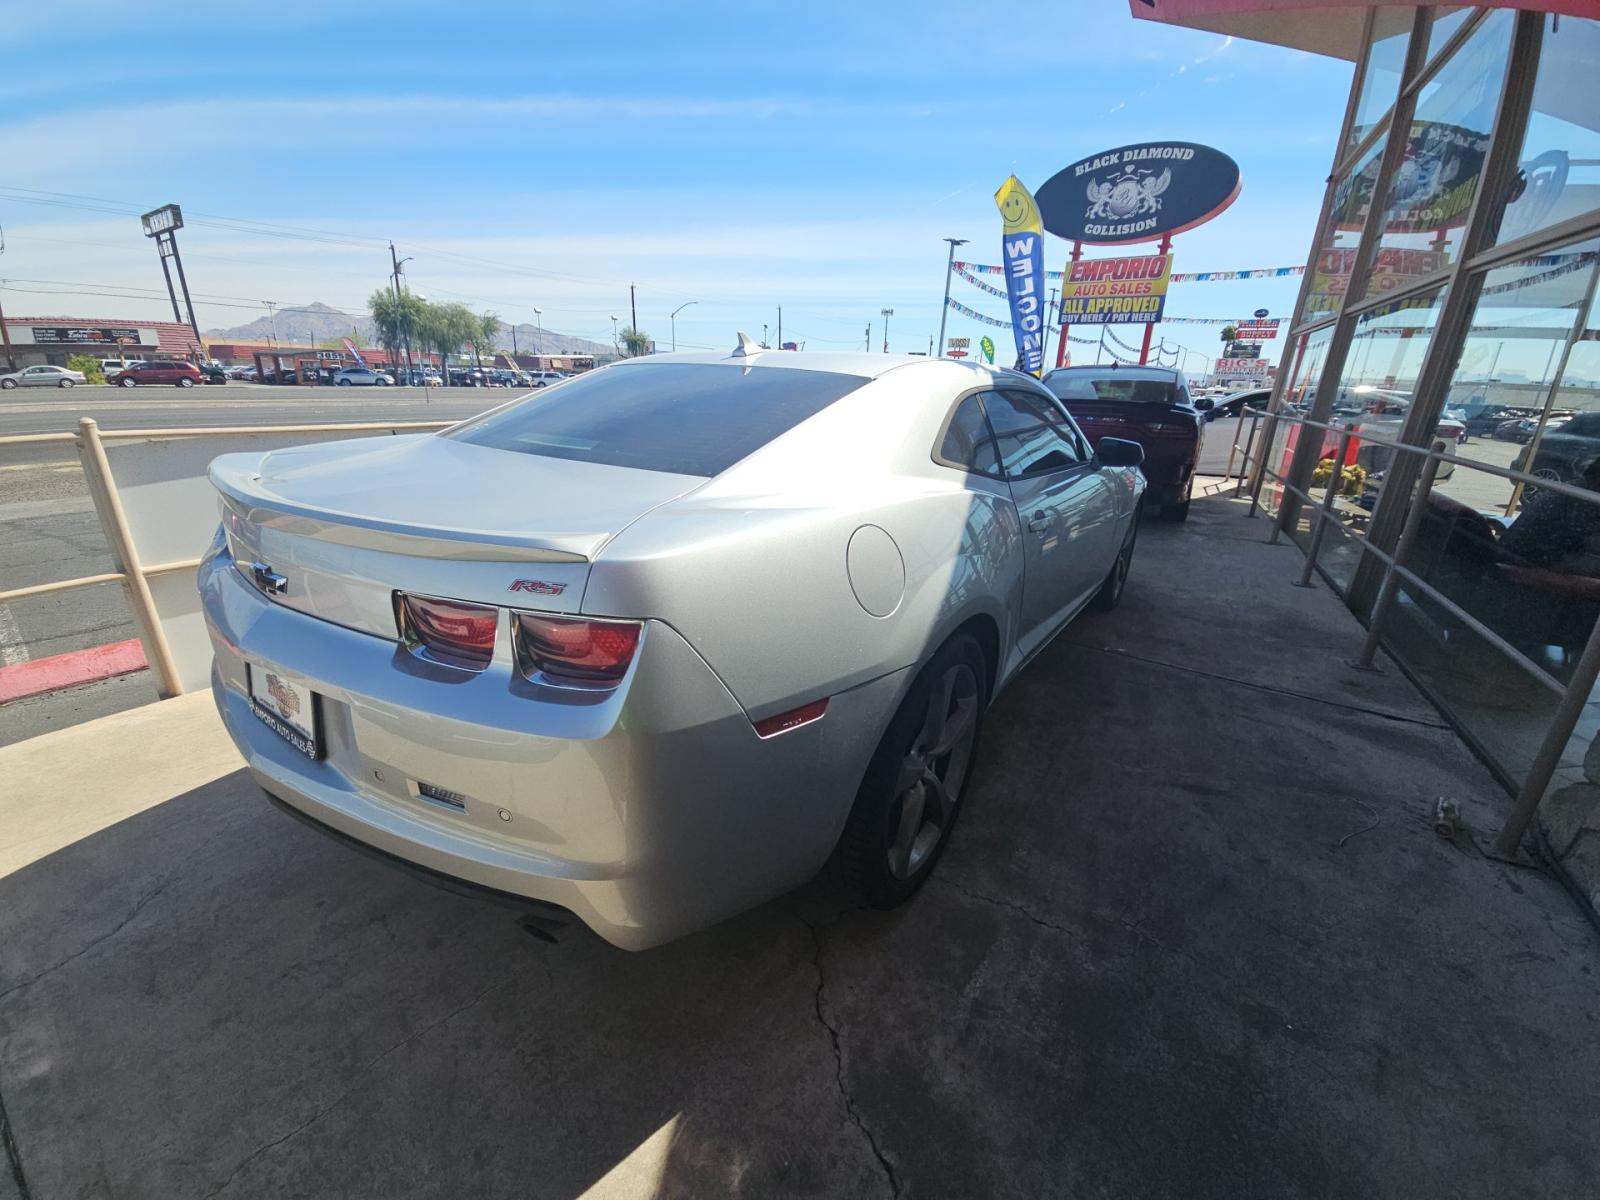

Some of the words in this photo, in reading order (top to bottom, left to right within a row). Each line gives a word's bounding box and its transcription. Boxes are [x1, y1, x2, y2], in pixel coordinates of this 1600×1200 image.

[1075, 153, 1120, 176] BLACK
[1123, 147, 1195, 162] DIAMOND
[1084, 217, 1157, 235] COLLISION
[1069, 256, 1168, 283] EMPORIO
[1073, 284, 1107, 296] AUTO
[1109, 282, 1152, 294] SALES
[1062, 299, 1084, 314] ALL
[1086, 296, 1160, 313] APPROVED
[1061, 313, 1080, 323] BUY
[1080, 313, 1104, 323] HERE
[1111, 312, 1131, 322] PAY
[1131, 312, 1157, 322] HERE
[506, 578, 567, 596] RS
